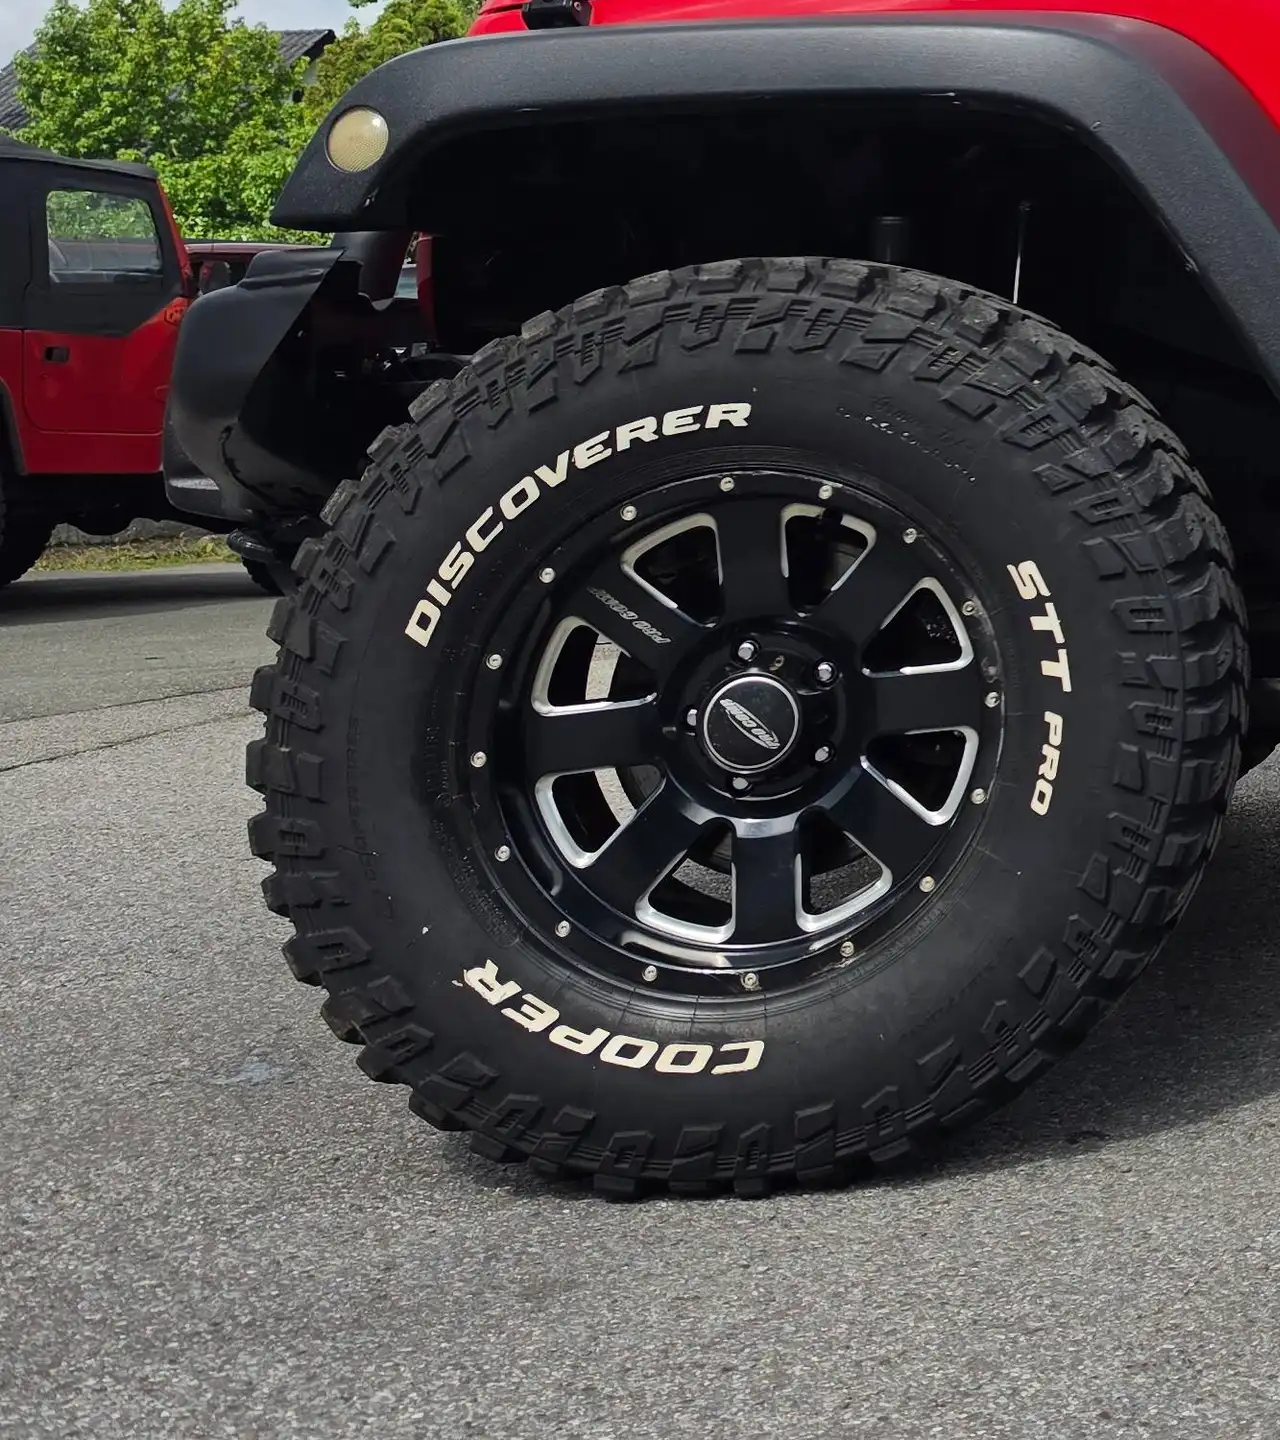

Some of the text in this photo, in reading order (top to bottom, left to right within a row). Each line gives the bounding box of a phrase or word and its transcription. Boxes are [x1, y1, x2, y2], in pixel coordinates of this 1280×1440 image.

[405, 402, 752, 647] DISCOVERER
[632, 620, 672, 644] PRO
[1006, 560, 1072, 816] STT PRO
[463, 958, 766, 1075] COOPER
